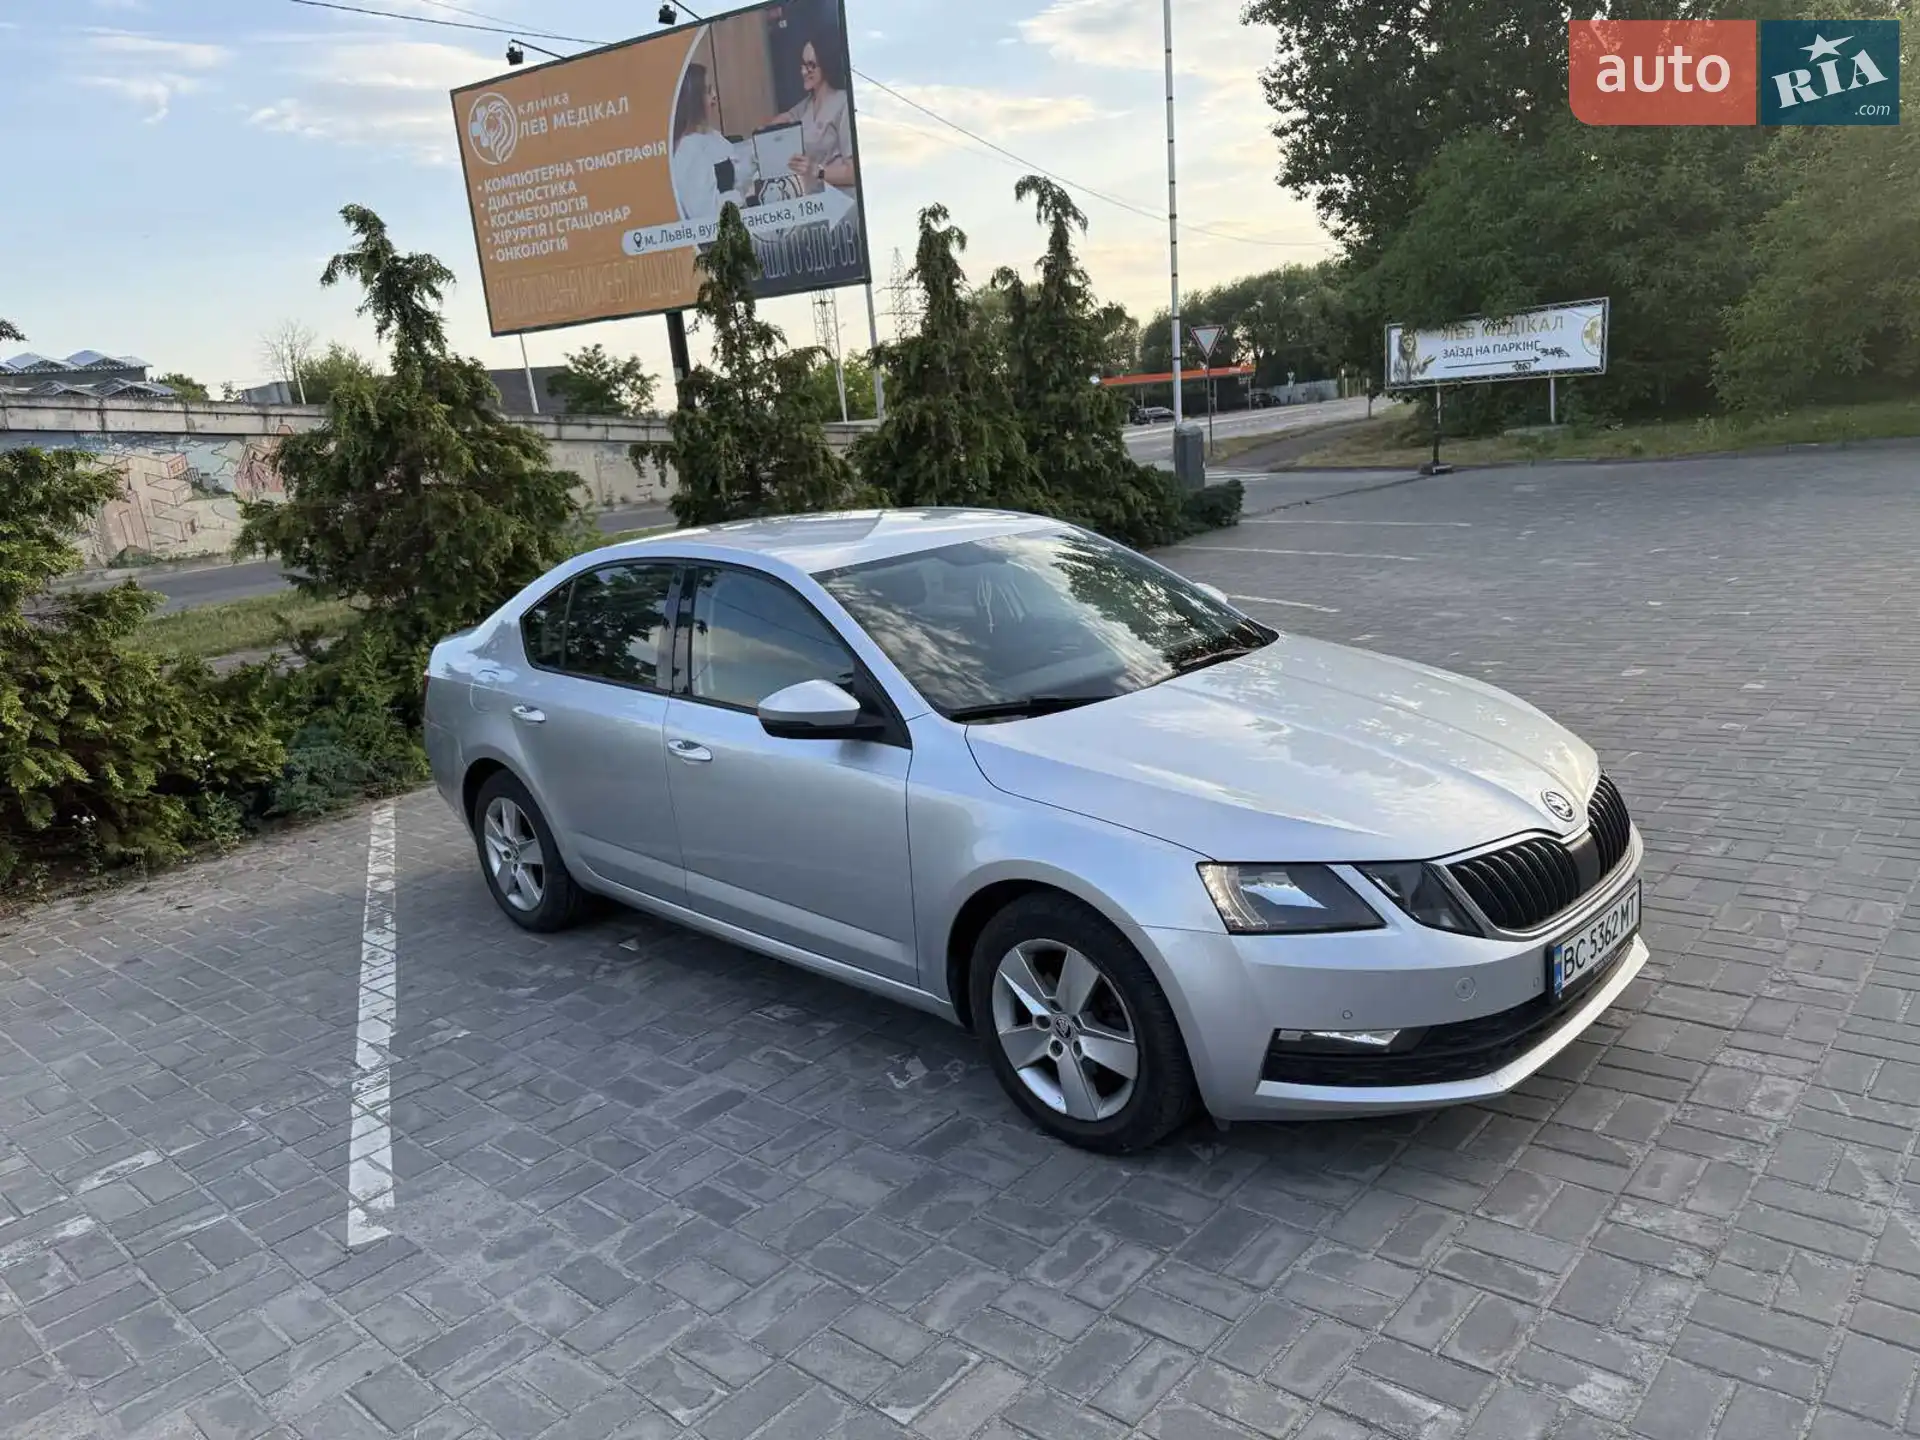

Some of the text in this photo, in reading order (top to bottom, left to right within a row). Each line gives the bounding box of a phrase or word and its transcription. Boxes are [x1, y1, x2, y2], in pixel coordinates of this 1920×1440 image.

[519, 95, 629, 140] ЛЕВ МЕДІКАЛ
[576, 140, 668, 174] ТОМОГРАФІЯ
[487, 180, 578, 213] ДІАГНОСТИКА
[490, 196, 589, 229] КОСМЕТОЛОГІЯ
[492, 220, 548, 247] ХІРУРГІЯ
[556, 206, 632, 235] СТАЦІОНАР
[645, 235, 657, 246] м.
[659, 224, 696, 244] Львів,
[797, 200, 825, 217] 18м
[496, 237, 569, 263] ОНКОЛОГІЯ
[1442, 346, 1474, 359] ЗАЇЗД
[1475, 345, 1491, 356] НА
[1492, 340, 1541, 354] ПАРКІНГ
[1563, 938, 1587, 981] BC
[1590, 911, 1618, 959] 5362
[1620, 892, 1636, 932] MT
